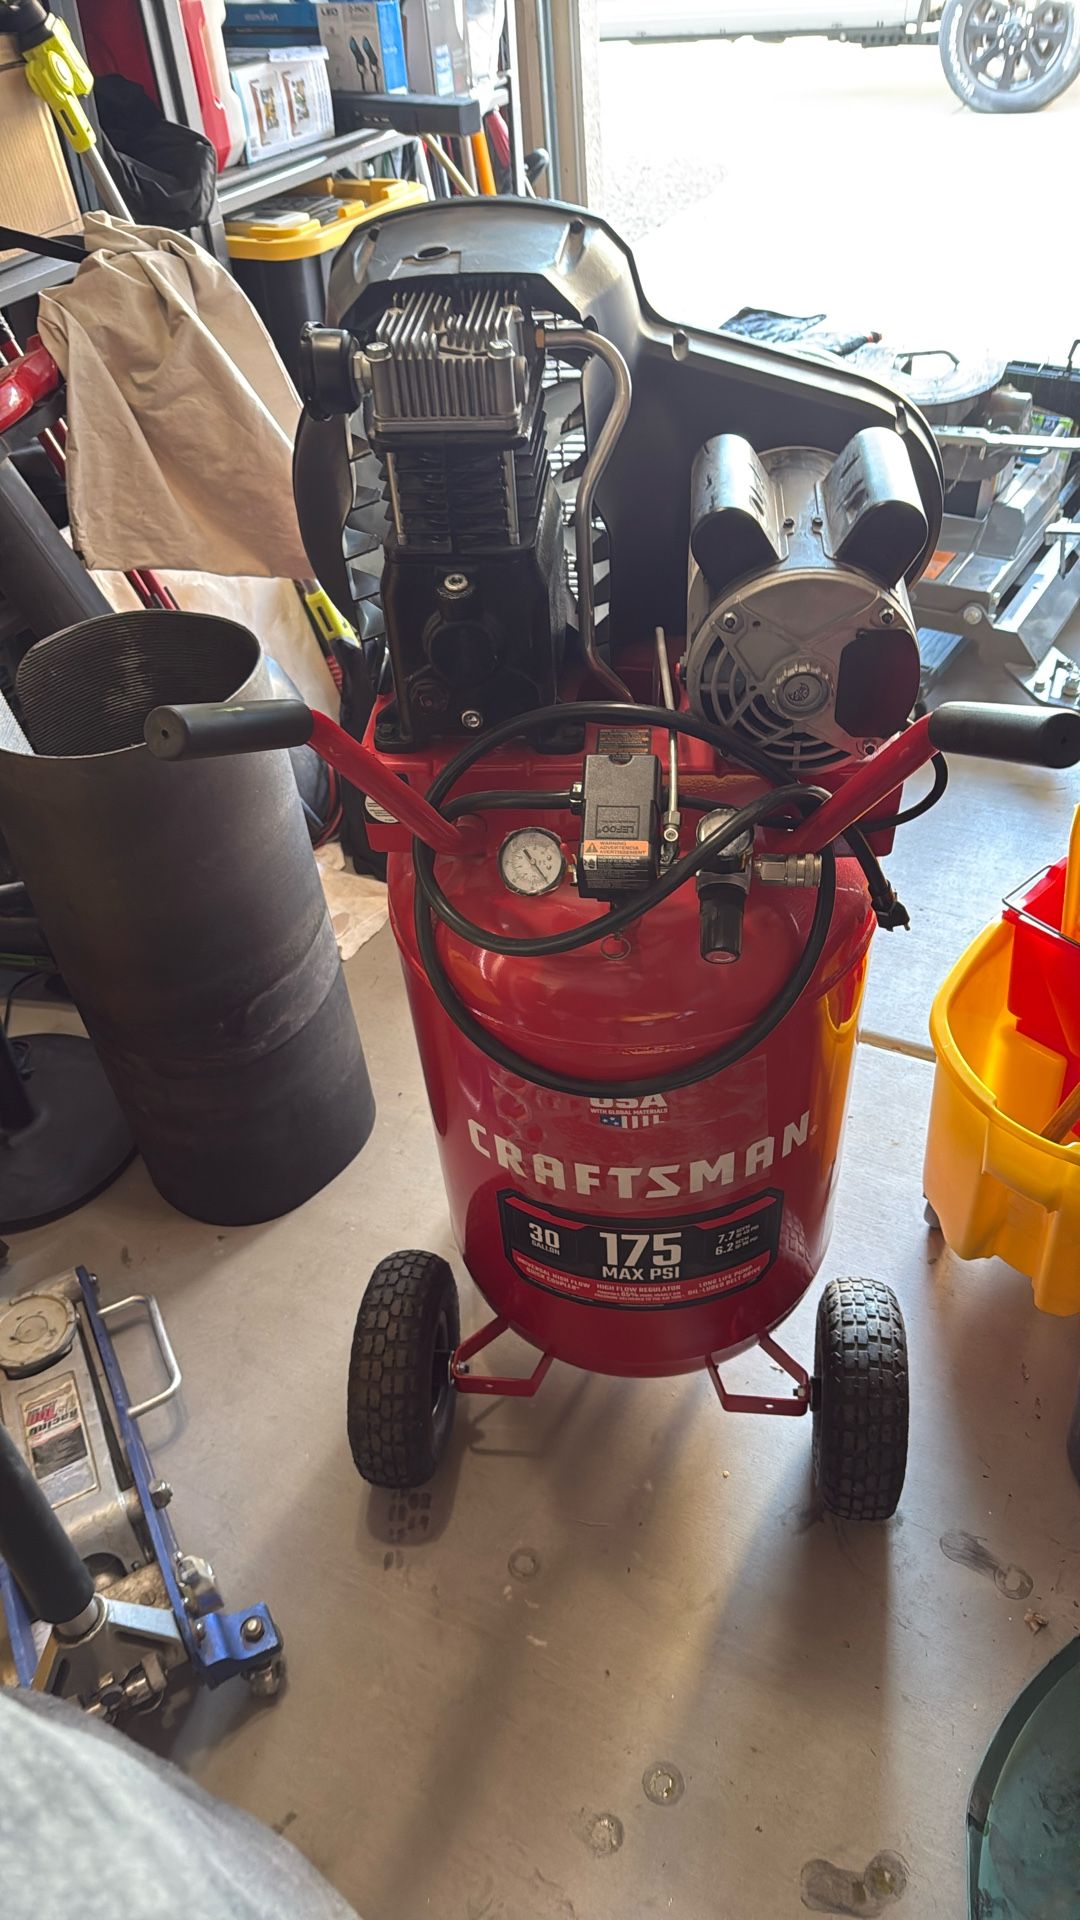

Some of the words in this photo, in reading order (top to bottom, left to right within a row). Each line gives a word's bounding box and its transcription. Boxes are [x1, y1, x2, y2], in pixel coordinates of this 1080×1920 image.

[590, 1094, 667, 1108] USA
[467, 1110, 811, 1199] CRAFTSMAN
[529, 1222, 560, 1248] 30
[717, 1230, 736, 1244] 7.7
[531, 1240, 560, 1255] GALLON
[599, 1231, 682, 1267] 175
[714, 1242, 735, 1256] 6.2
[602, 1266, 644, 1281] MAX
[649, 1266, 680, 1280] PSI
[596, 1283, 615, 1291] HIGH
[638, 1284, 681, 1293] REGULATOR
[698, 1278, 718, 1288] LONG
